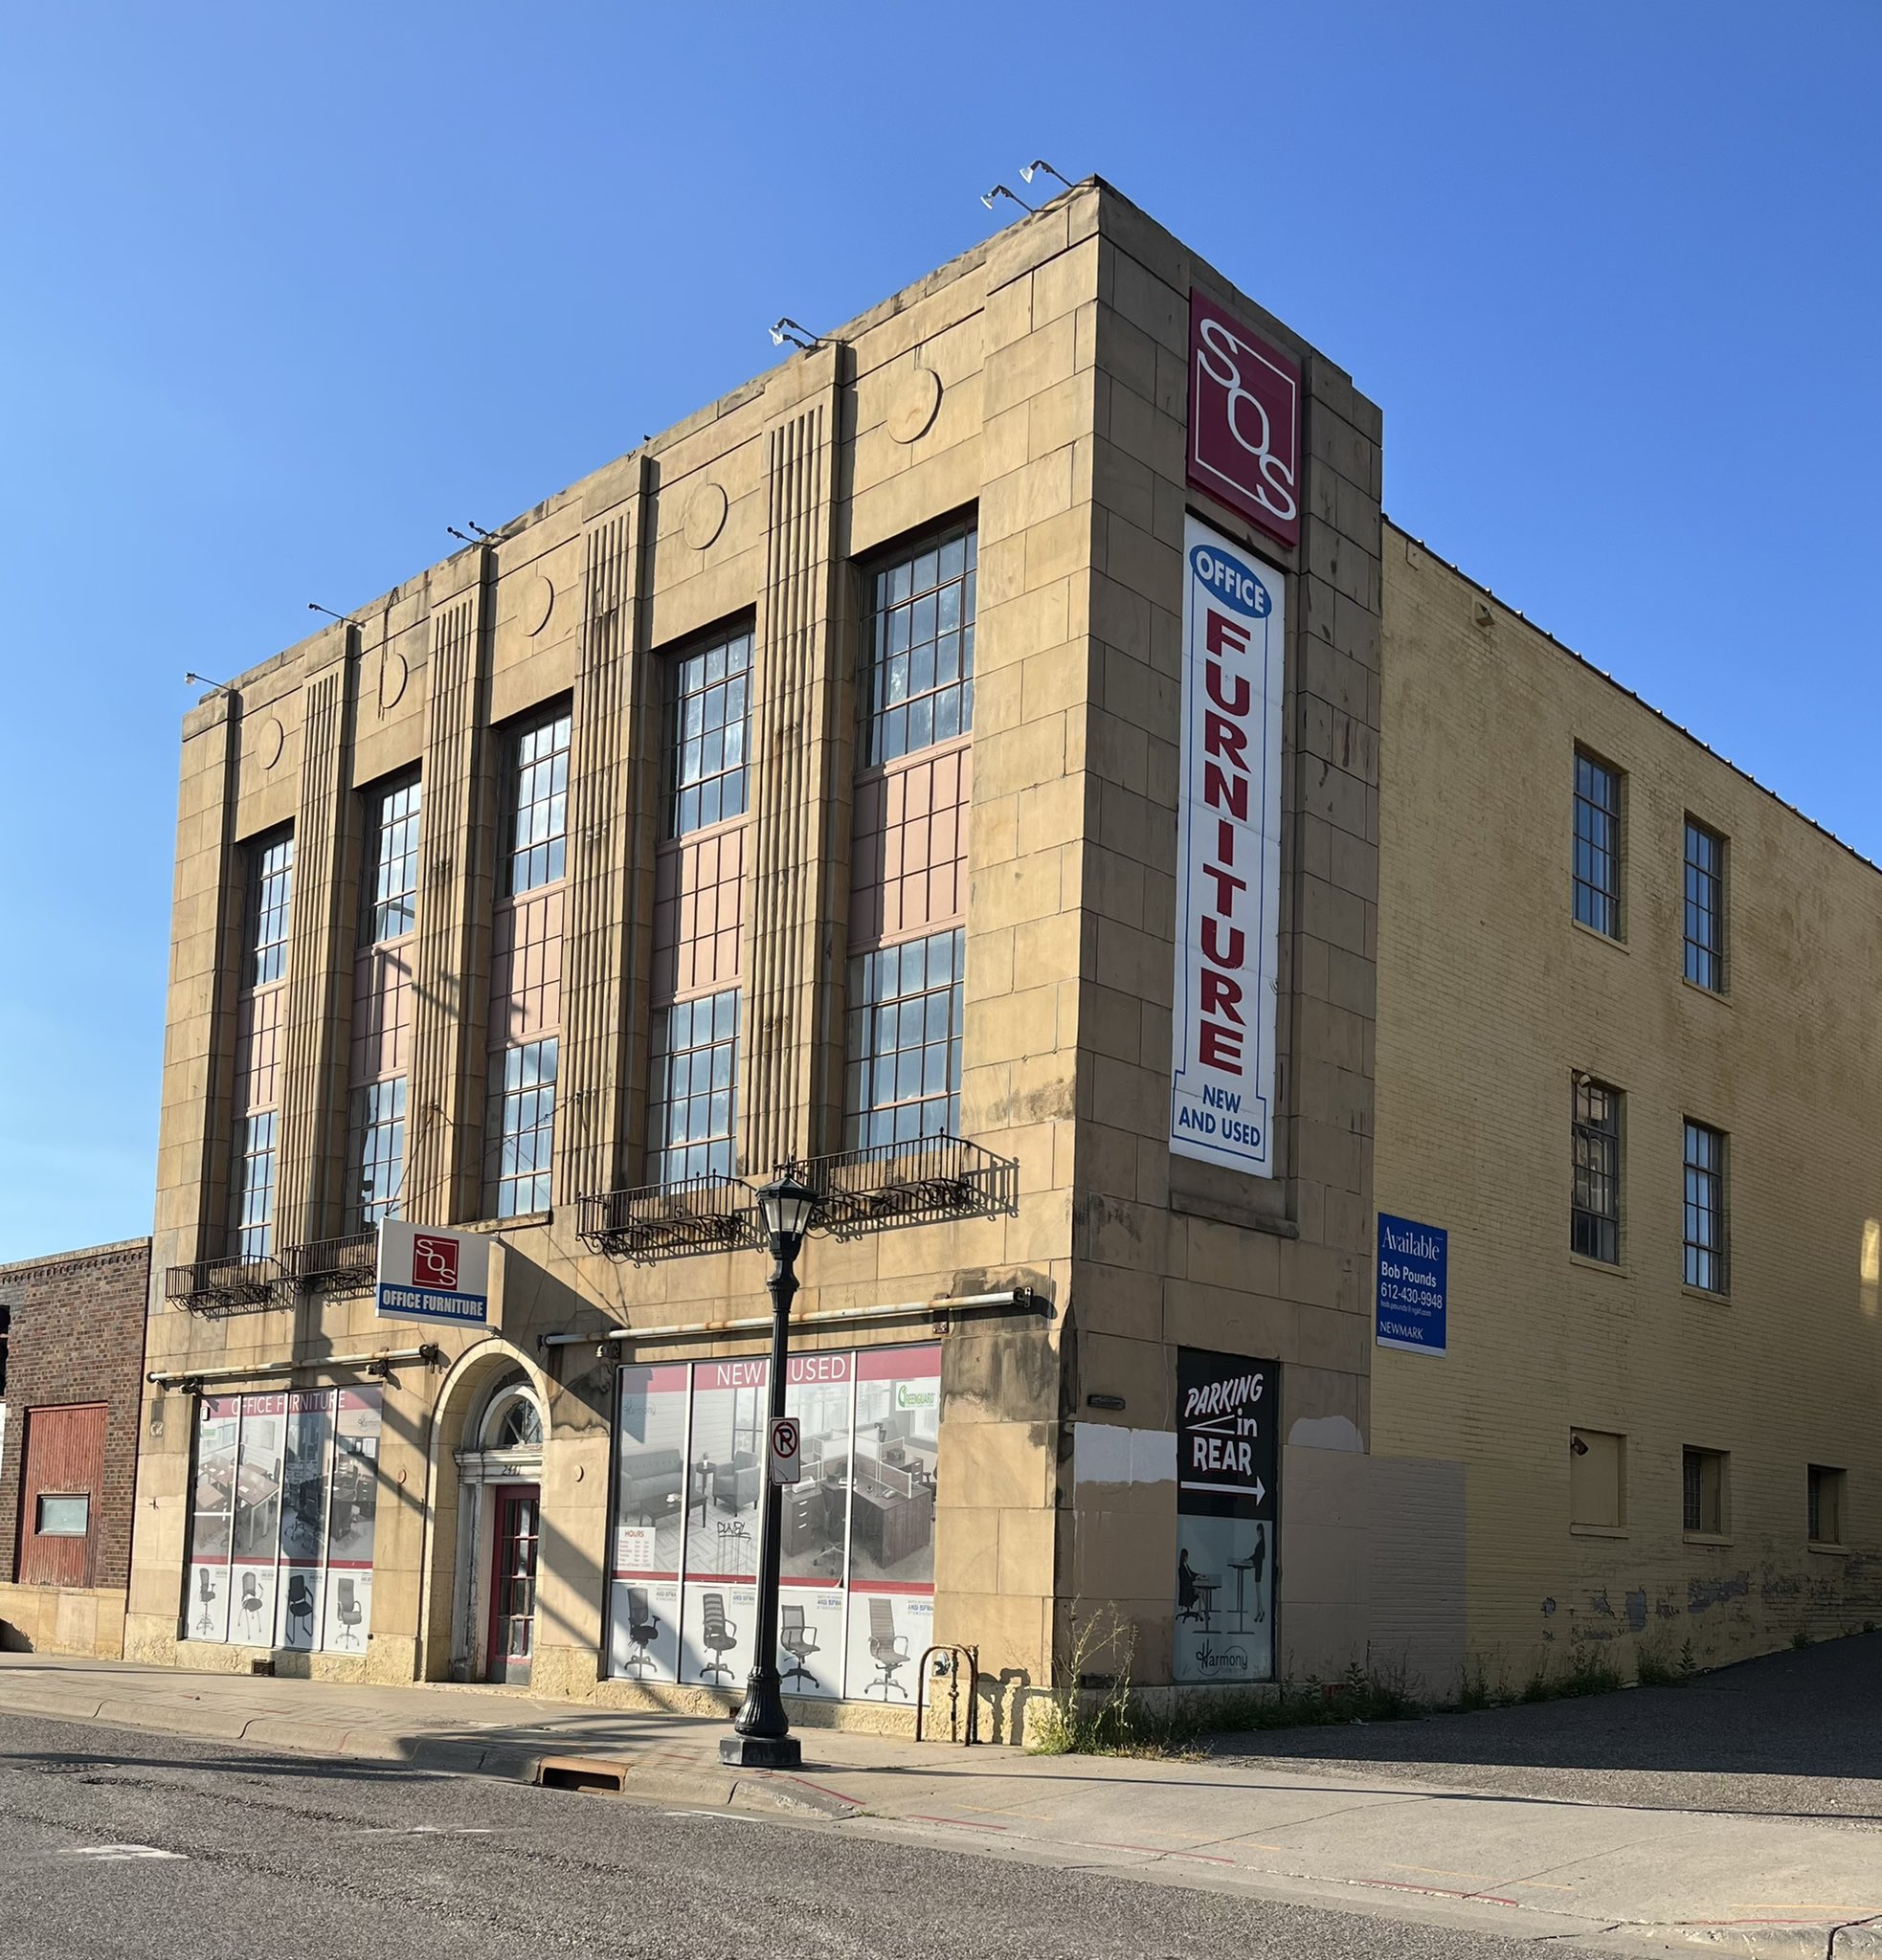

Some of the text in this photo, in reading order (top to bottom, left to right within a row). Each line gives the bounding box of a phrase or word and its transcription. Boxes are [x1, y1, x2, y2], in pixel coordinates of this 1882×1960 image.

[1198, 319, 1296, 520] SOS
[1197, 550, 1265, 613] OFFICE
[1199, 608, 1252, 1076] FURNITURE
[1202, 1083, 1242, 1114] NEW
[1178, 1106, 1261, 1147] AND USED
[1381, 1226, 1440, 1261] Available
[415, 1238, 457, 1286] SOS
[1381, 1261, 1437, 1288] Bob Pounds
[383, 1289, 483, 1316] OFFICE FURNITURE
[1380, 1282, 1443, 1309] 612-430-9948
[1379, 1321, 1423, 1340] NEWMARK
[717, 1356, 845, 1386] NEW USED
[1184, 1373, 1264, 1417] PARKING
[1237, 1408, 1258, 1437] in
[1193, 1437, 1252, 1476] REAR
[1196, 1638, 1248, 1670] Harmony
